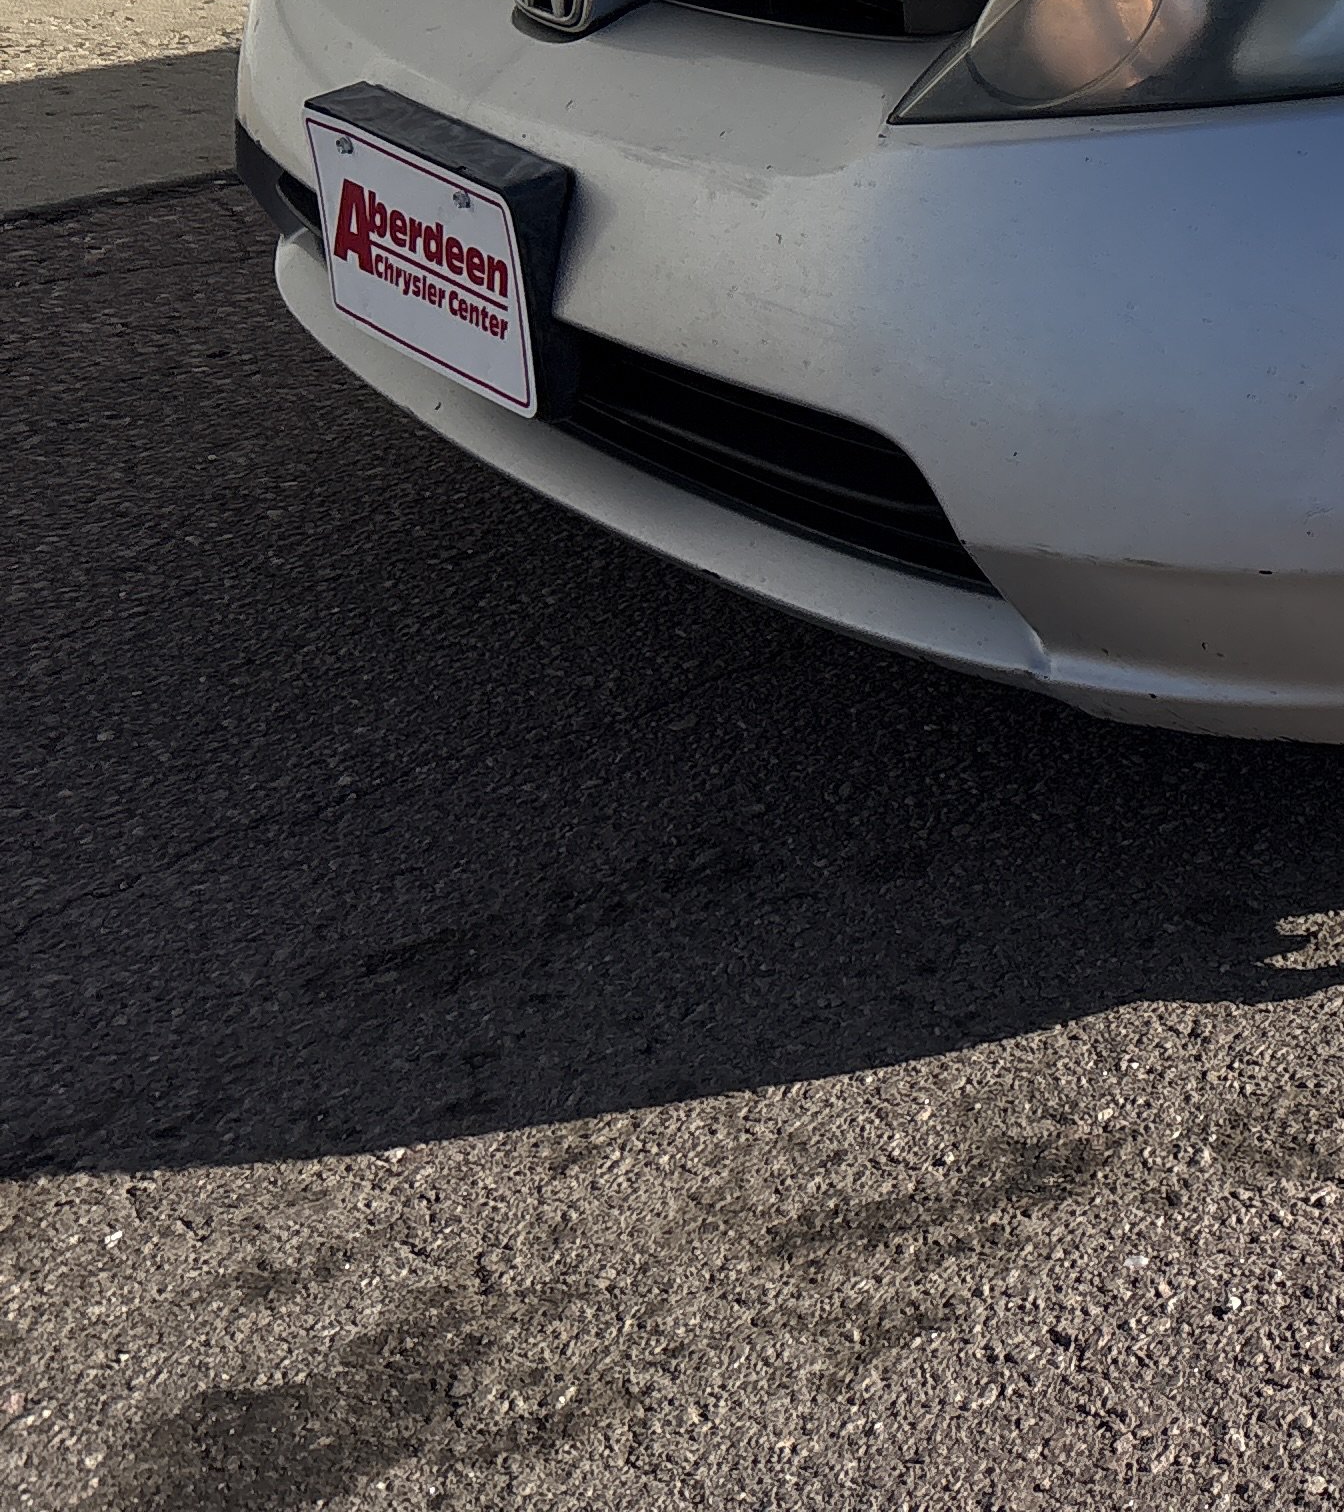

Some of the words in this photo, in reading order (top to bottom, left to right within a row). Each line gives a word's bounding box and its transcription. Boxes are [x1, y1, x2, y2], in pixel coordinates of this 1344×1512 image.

[333, 178, 509, 299] Aberdeen
[374, 253, 446, 309] Chrysler
[448, 290, 509, 340] Center
